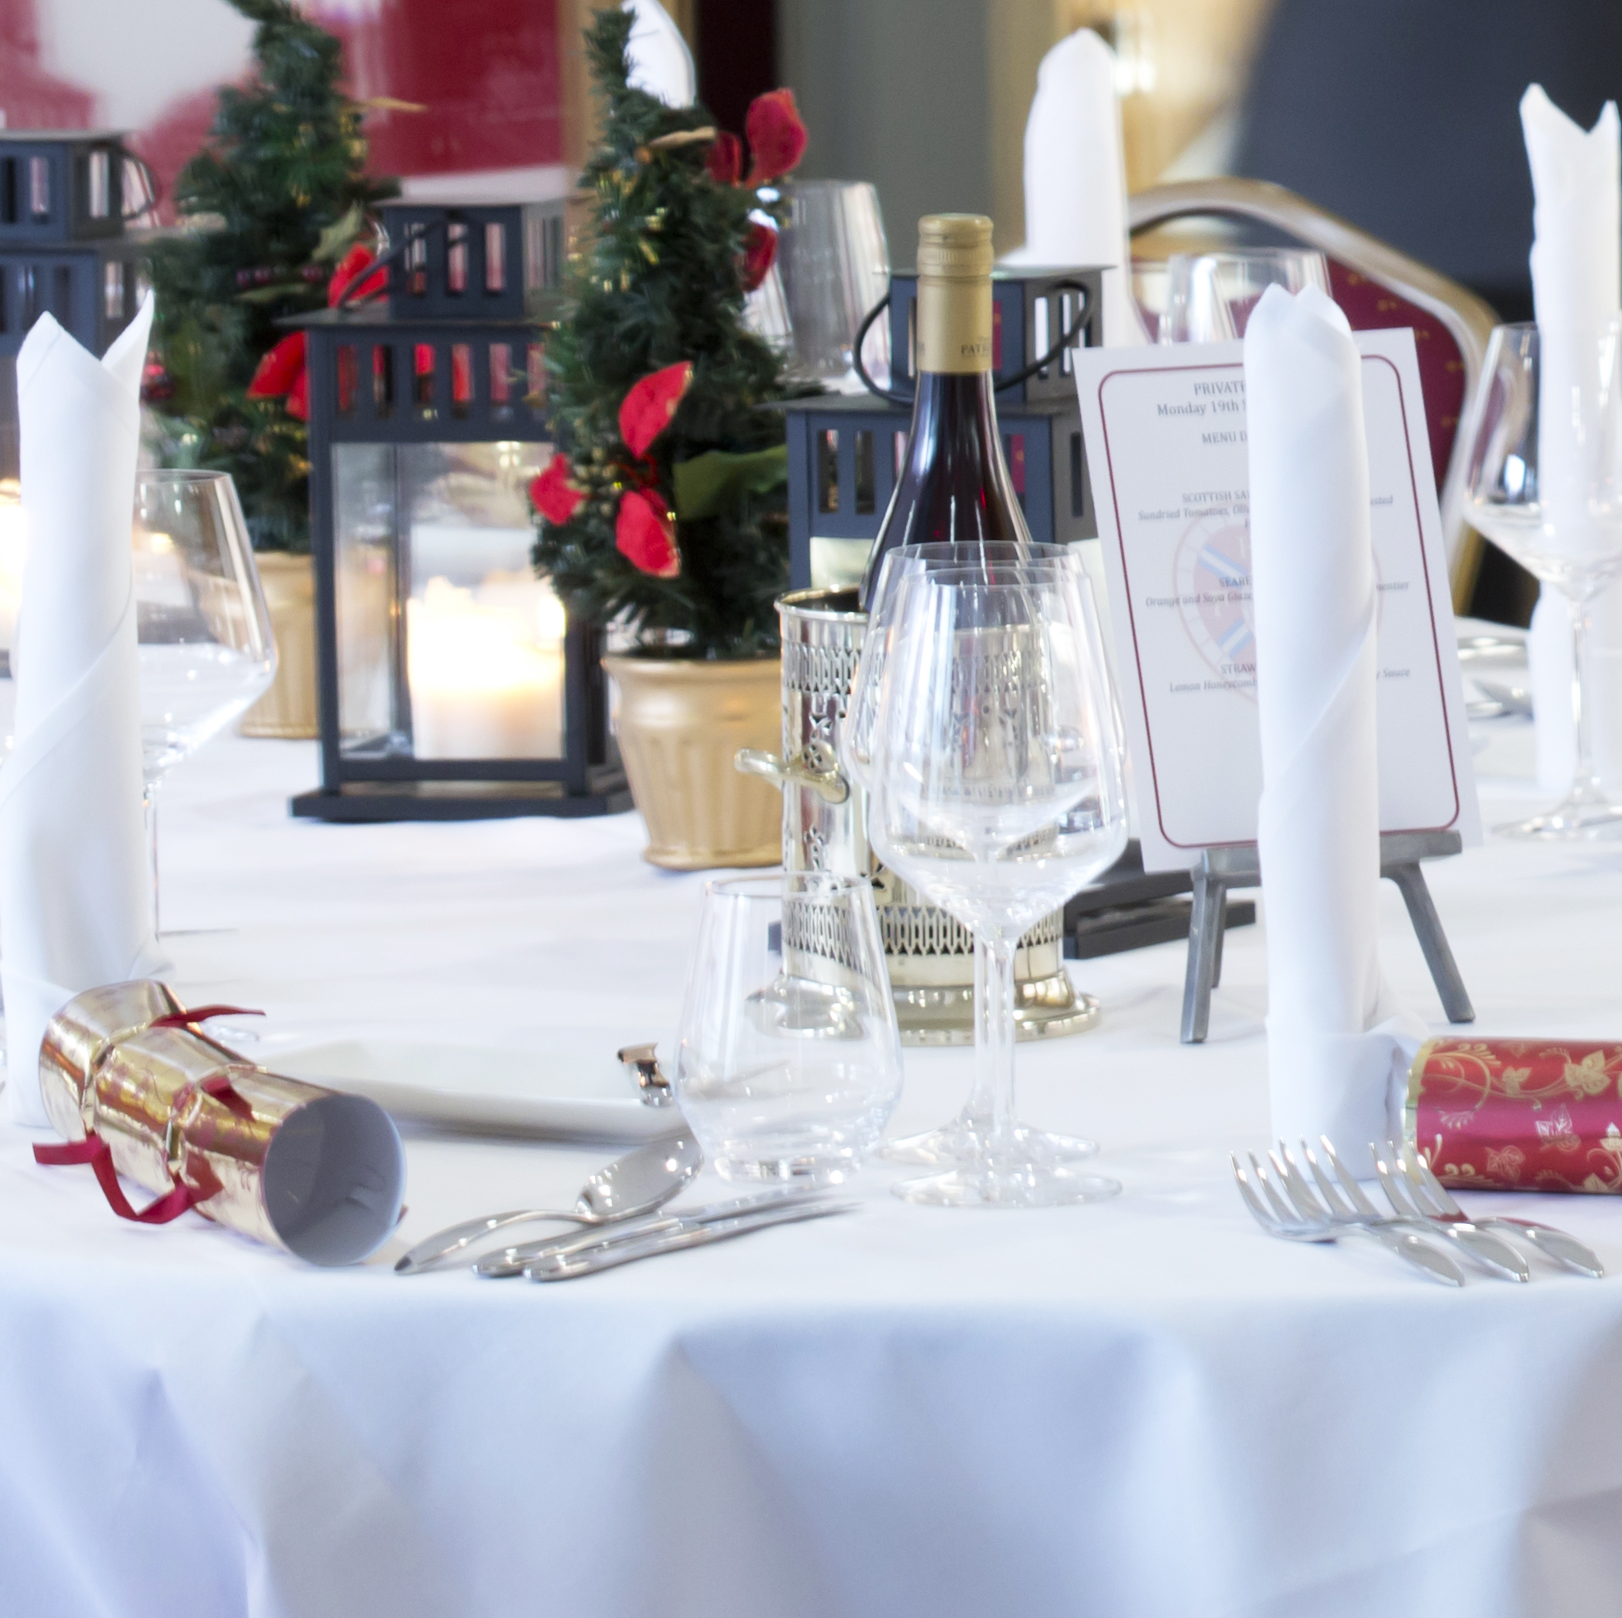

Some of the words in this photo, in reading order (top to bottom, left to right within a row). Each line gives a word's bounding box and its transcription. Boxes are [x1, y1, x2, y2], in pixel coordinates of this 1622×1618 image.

[1157, 402, 1206, 417] Monday
[1211, 398, 1239, 414] 19th
[1202, 432, 1236, 444] MENU
[1182, 490, 1231, 503] SCOTTISH
[1138, 508, 1180, 521] Sundried
[1145, 596, 1180, 608] Orange
[1182, 593, 1200, 604] and
[1169, 682, 1201, 693] Lemon
